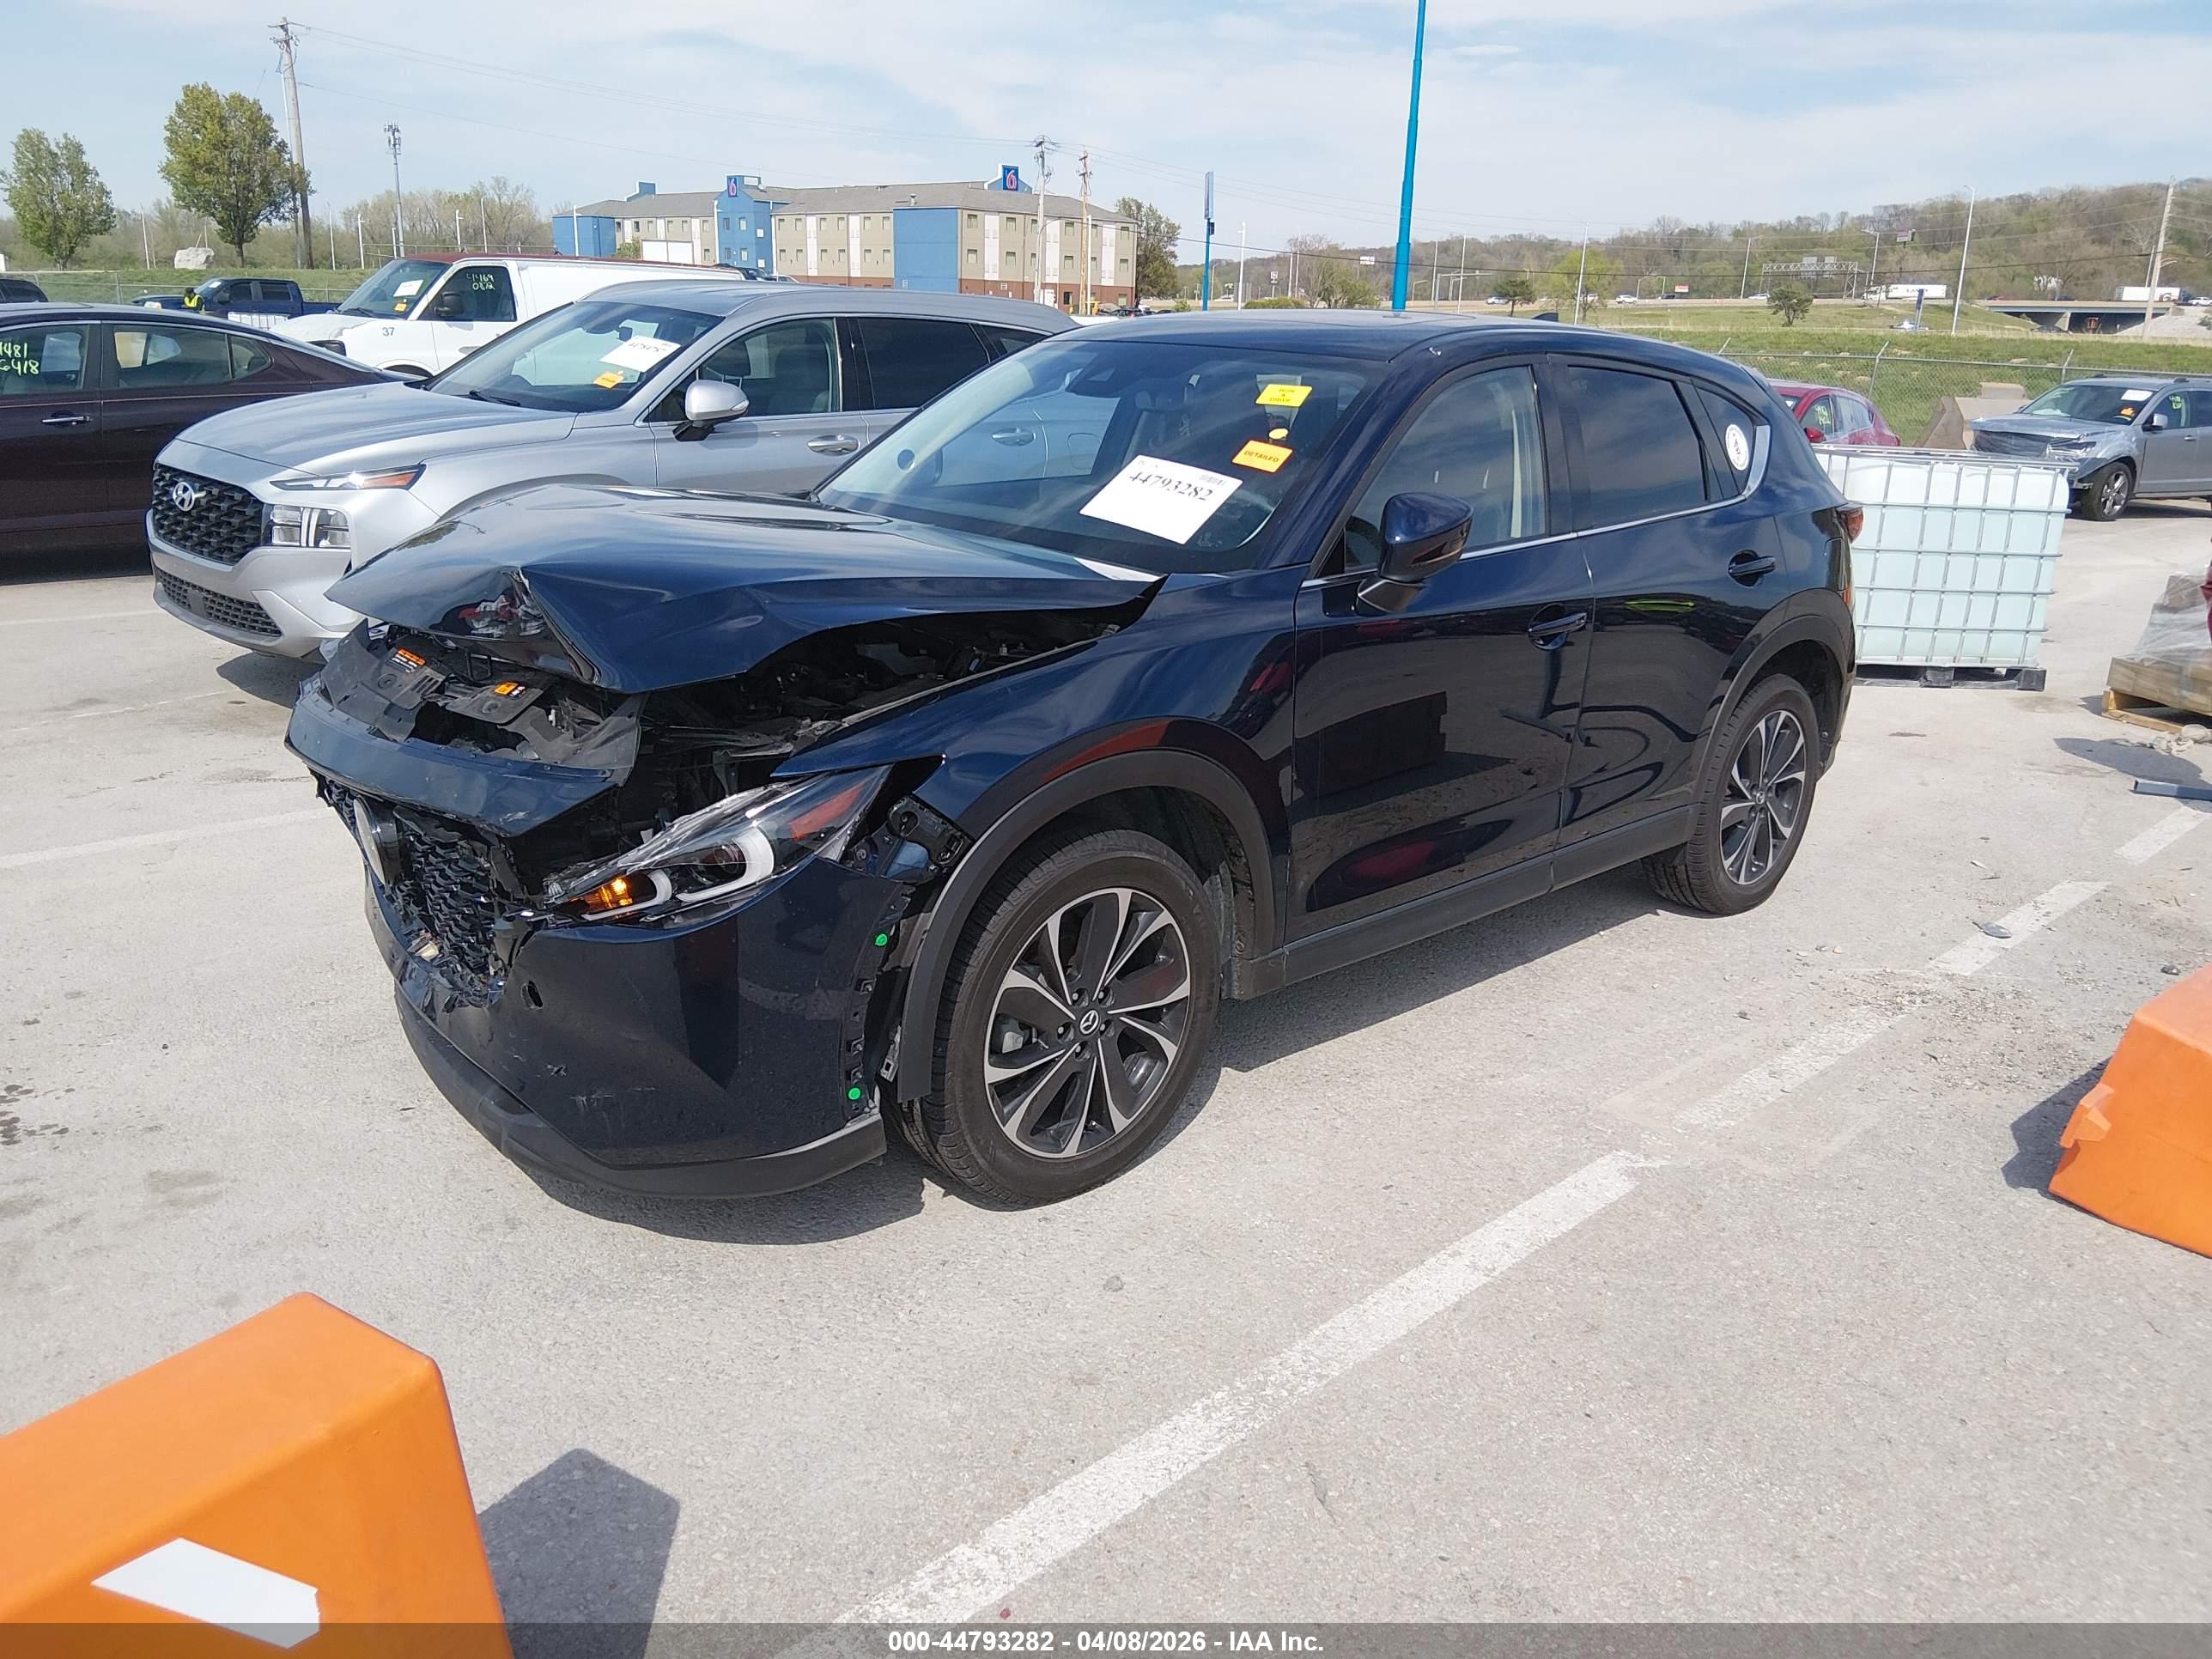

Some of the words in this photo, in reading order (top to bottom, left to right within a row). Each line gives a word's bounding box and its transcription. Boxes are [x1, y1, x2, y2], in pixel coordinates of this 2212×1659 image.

[729, 178, 737, 197] 6
[1006, 169, 1018, 190] 6
[382, 327, 395, 337] 37
[1244, 450, 1279, 463] DETAILED
[1129, 471, 1213, 501] 44793282
